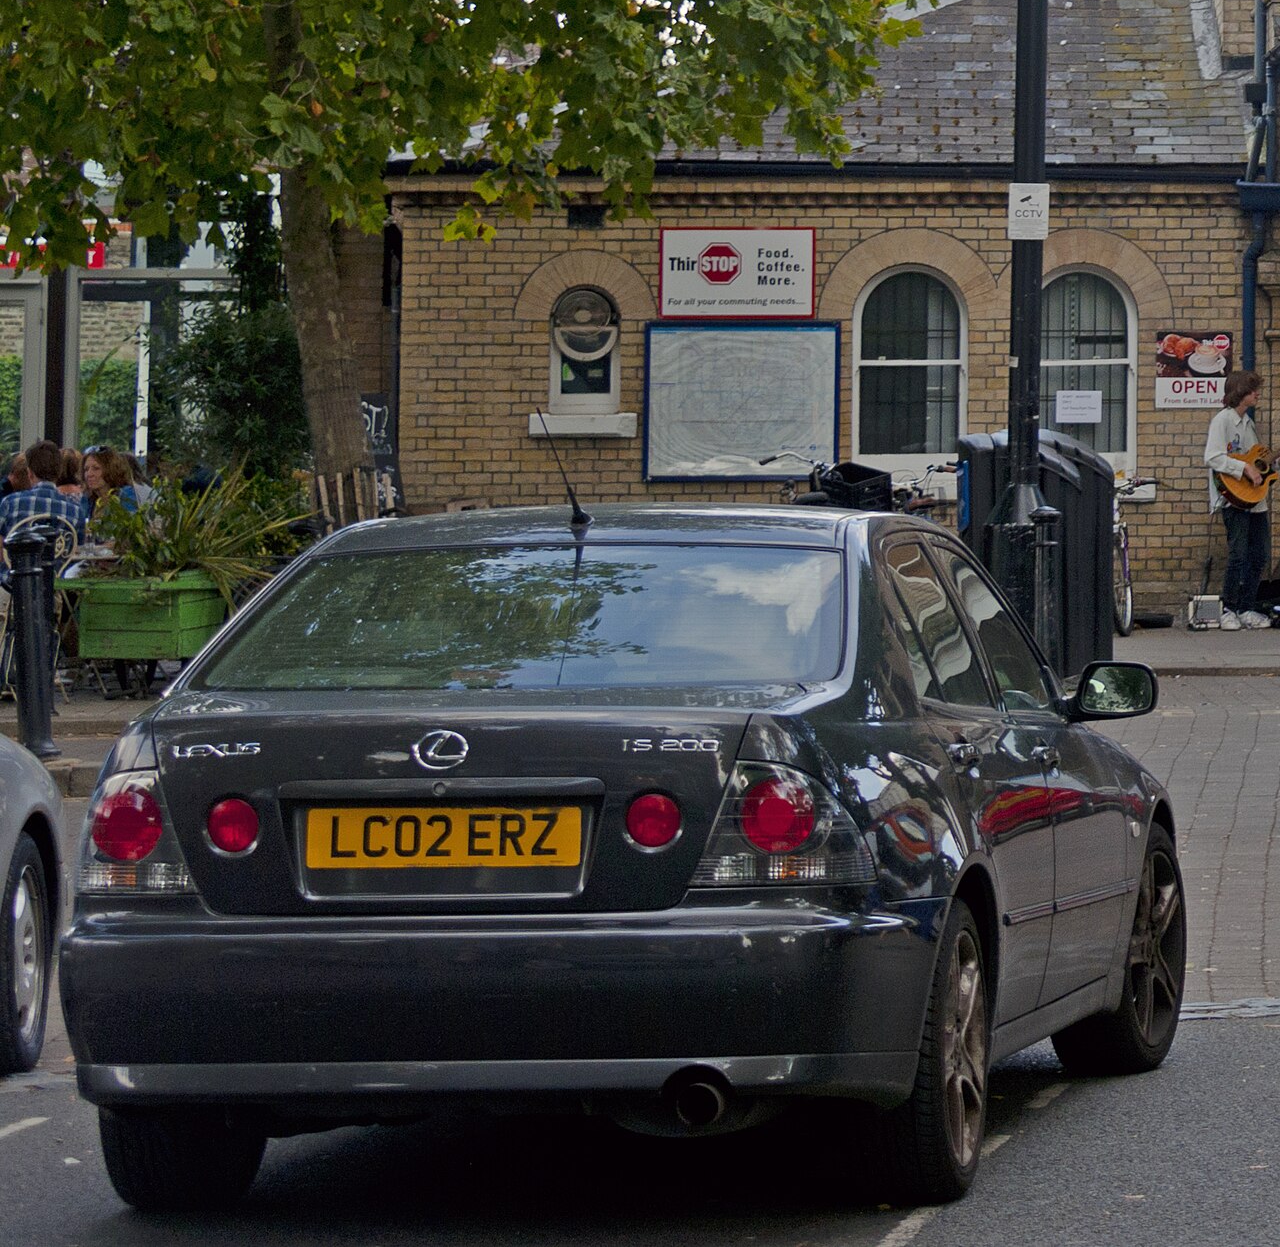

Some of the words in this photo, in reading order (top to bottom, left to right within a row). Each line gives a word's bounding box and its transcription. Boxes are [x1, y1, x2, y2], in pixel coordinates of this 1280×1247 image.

[1015, 209, 1043, 218] CCTV
[757, 248, 794, 258] Food.
[701, 256, 738, 272] STOP
[757, 261, 805, 272] Coffee.
[757, 275, 795, 286] More.
[697, 299, 717, 307] your
[718, 298, 767, 307] commuting
[1172, 380, 1217, 393] OPEN
[173, 742, 261, 758] LEXUS
[622, 738, 653, 752] IS
[659, 738, 719, 752] 200
[330, 814, 453, 858] LC02
[467, 813, 560, 857] ERZ
